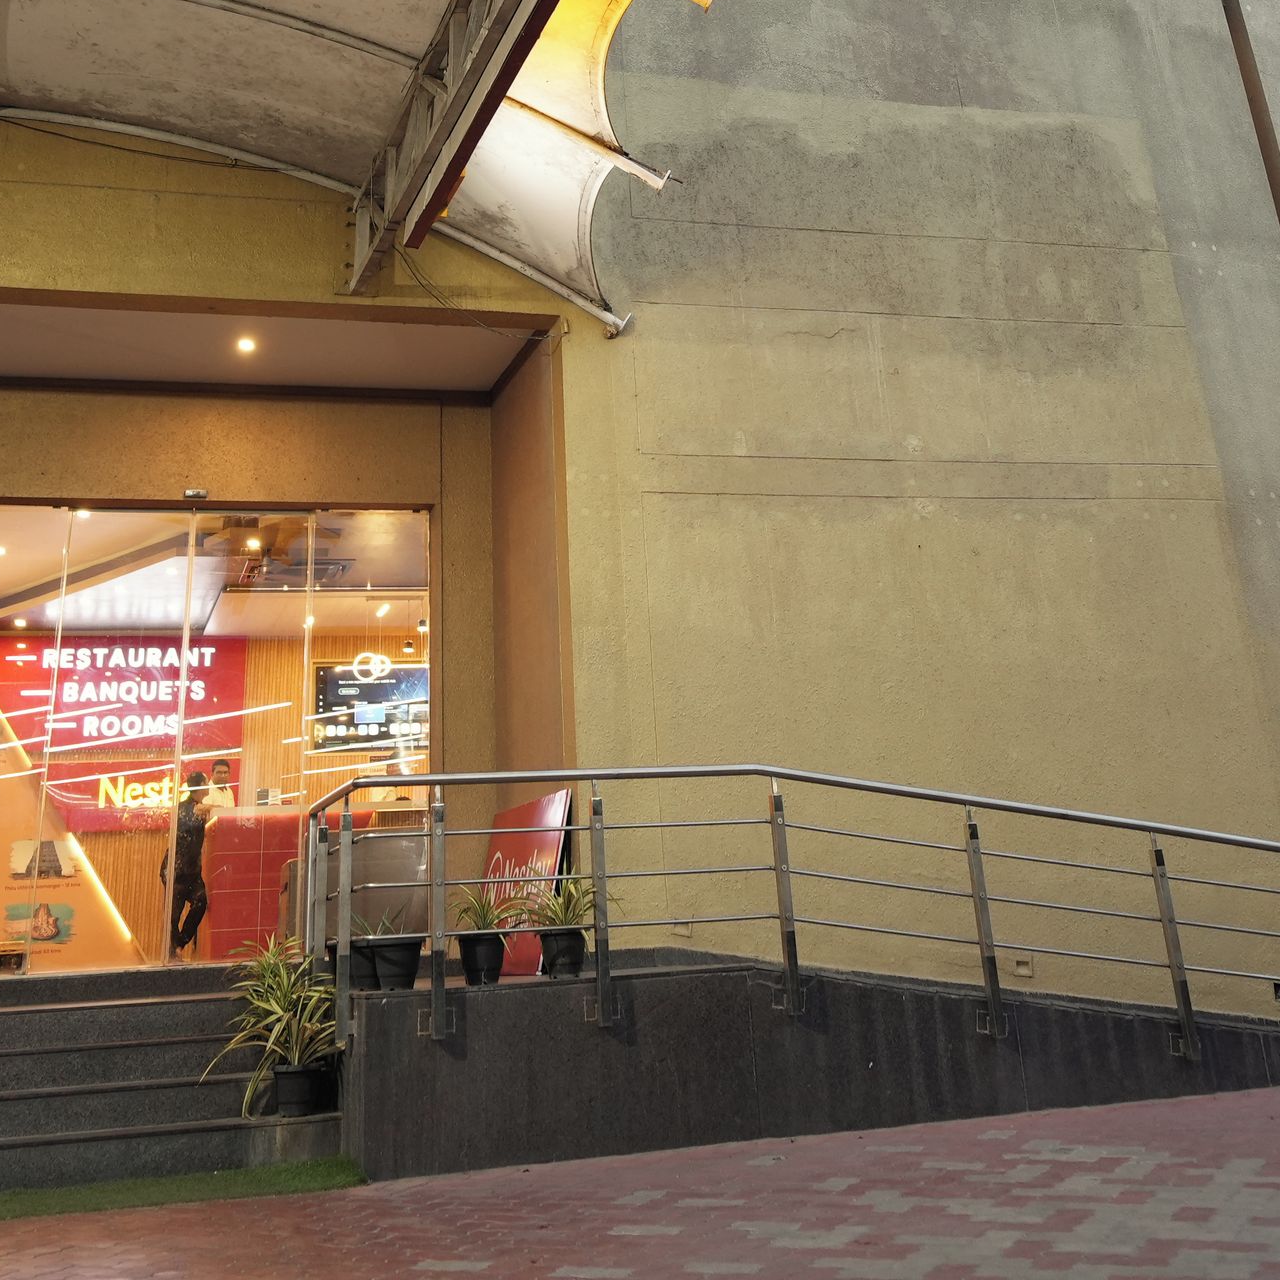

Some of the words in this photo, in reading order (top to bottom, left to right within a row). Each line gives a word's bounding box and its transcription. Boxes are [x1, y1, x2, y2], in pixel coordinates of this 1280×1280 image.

[42, 647, 217, 669] RESTAURANT
[62, 680, 206, 704] BANQUETS
[82, 713, 180, 737] ROOMS
